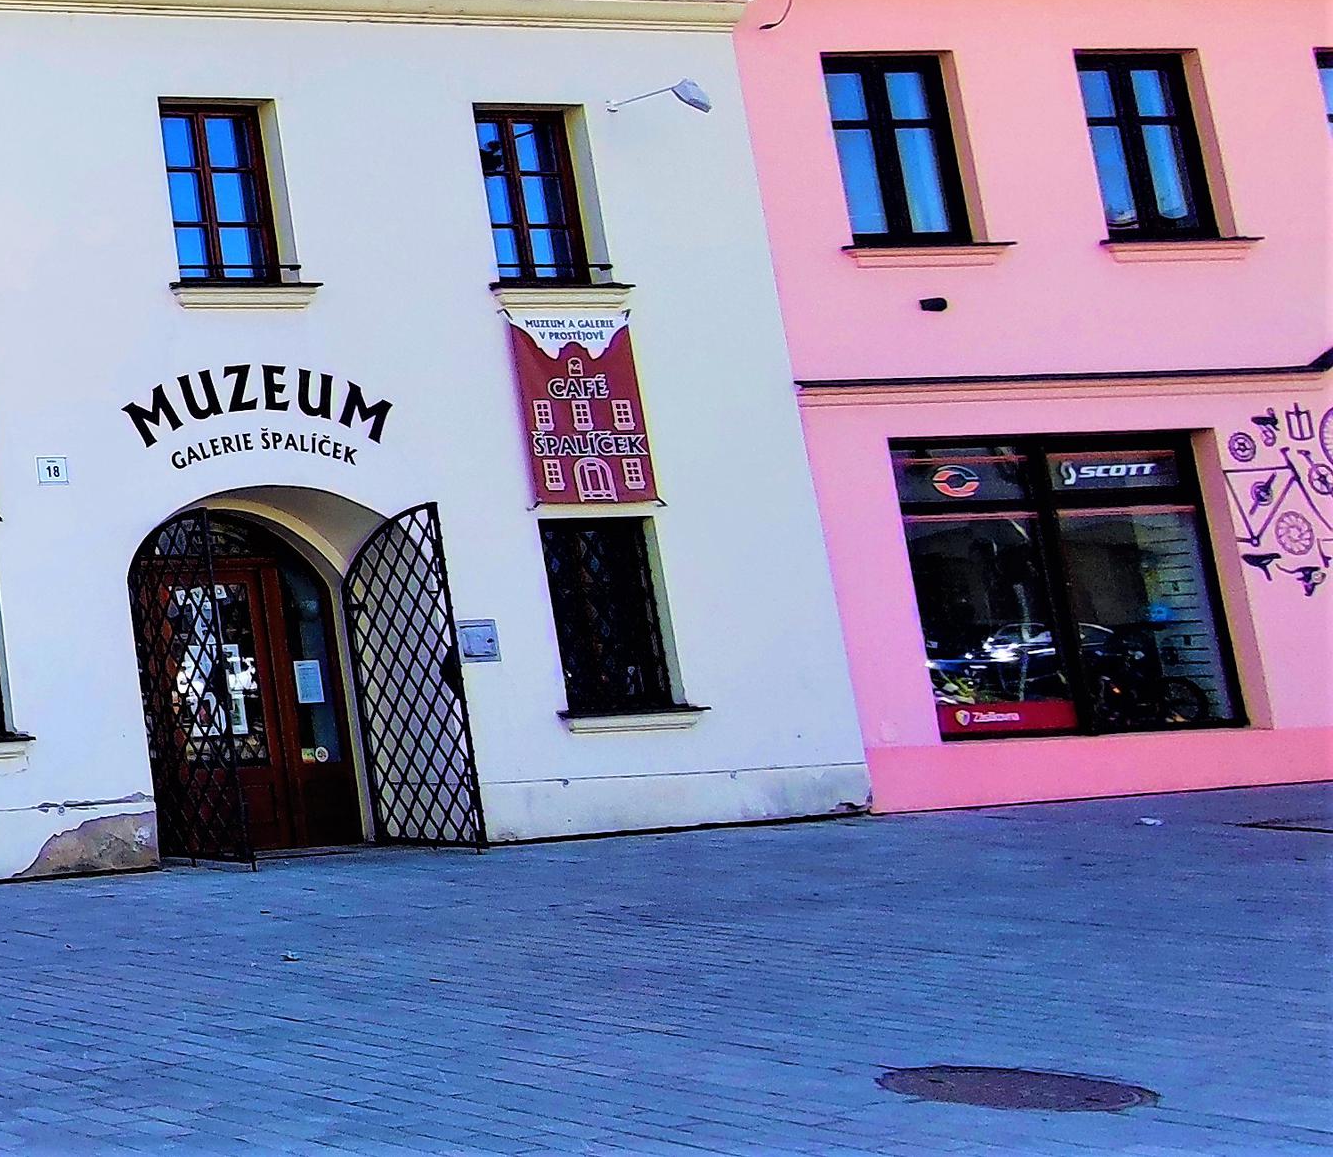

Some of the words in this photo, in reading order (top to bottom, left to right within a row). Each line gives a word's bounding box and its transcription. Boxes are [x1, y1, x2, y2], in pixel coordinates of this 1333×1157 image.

[525, 319, 565, 329] MUZEUM
[578, 319, 615, 329] GALERIE
[538, 331, 545, 341] V
[547, 373, 609, 399] CAFÉ
[120, 364, 393, 448] MUZEUM
[171, 432, 254, 470] GALERIE
[260, 427, 358, 466] ŠPALÍČEK
[531, 431, 648, 457] ŠPALÍČEK
[46, 465, 60, 478] 18
[1078, 463, 1157, 478] SCOTT
